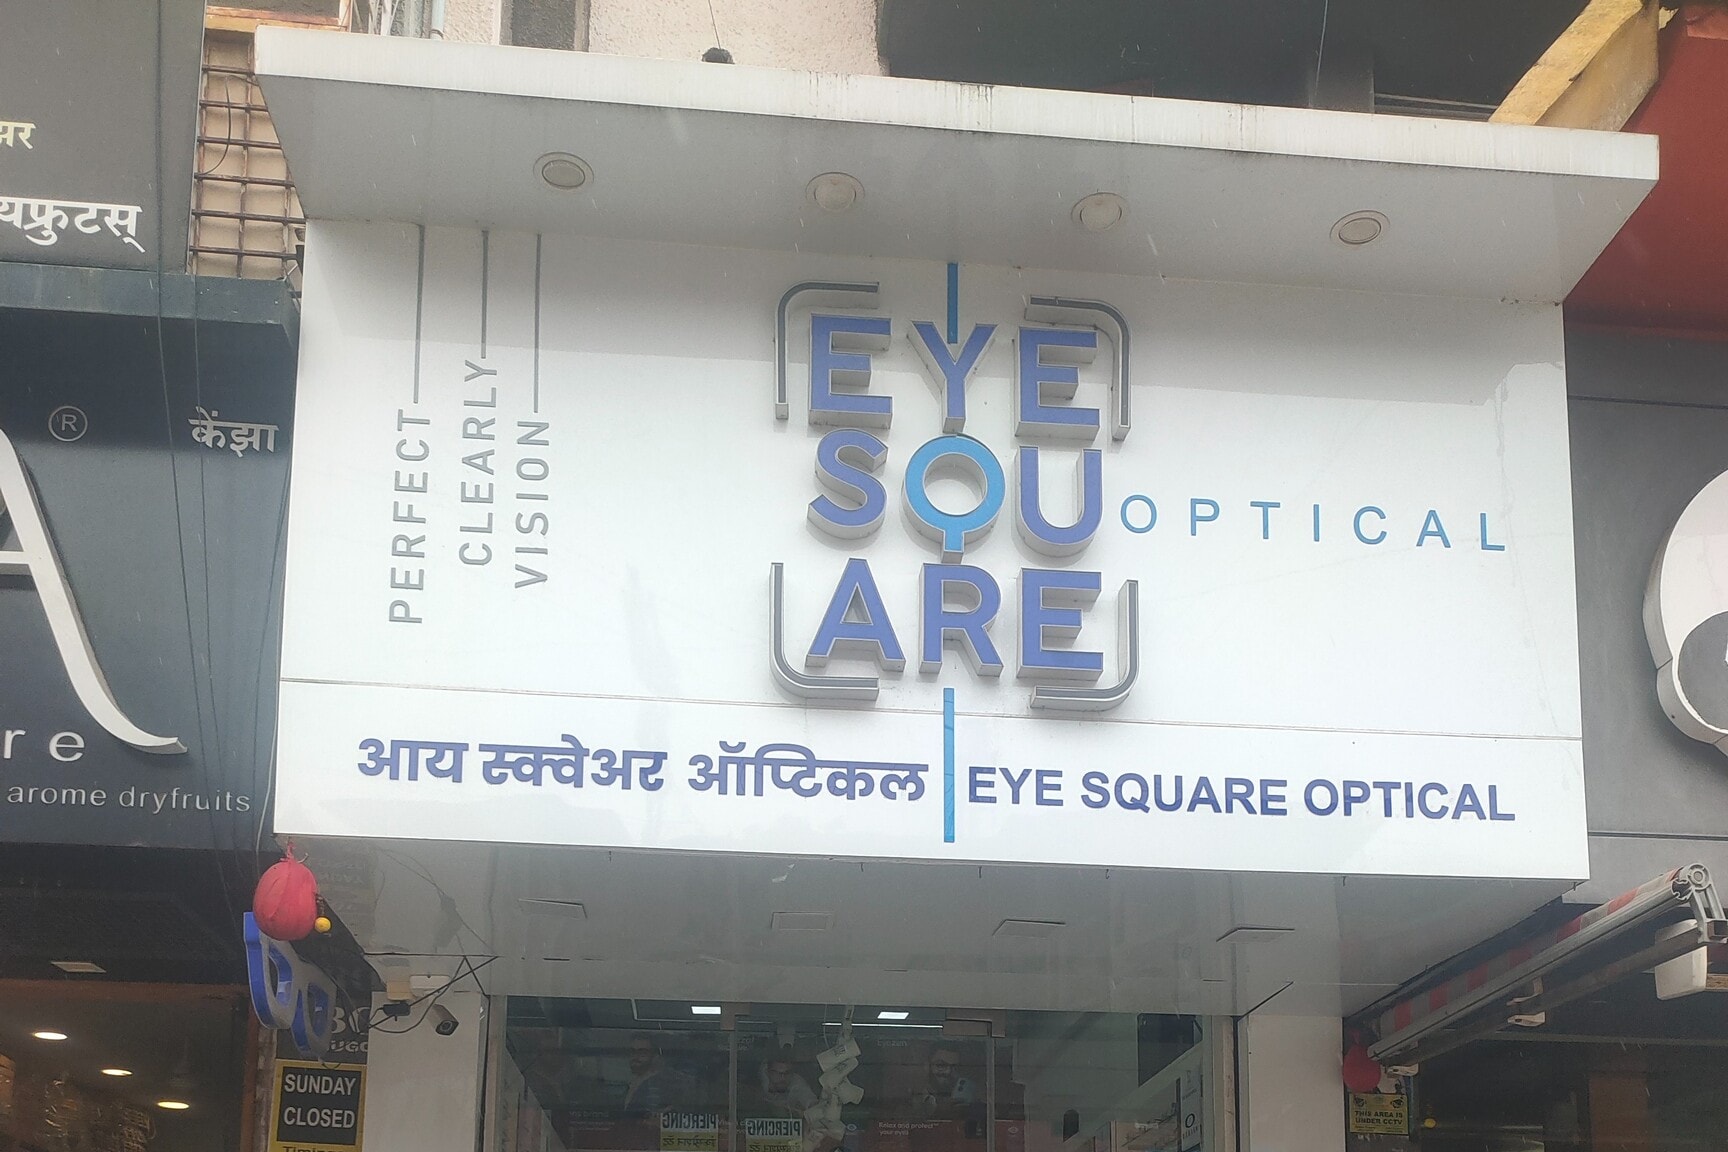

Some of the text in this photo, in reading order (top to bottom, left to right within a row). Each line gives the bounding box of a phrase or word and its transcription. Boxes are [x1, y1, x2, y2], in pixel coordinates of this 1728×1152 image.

[458, 359, 499, 567] CLEARLY
[389, 408, 431, 624] PERFECT
[515, 420, 552, 590] VISION
[1120, 493, 1506, 552] OPTICAL
[357, 733, 929, 803] आय स्क्वेअर ऑप्टिकल
[967, 767, 1515, 822] EYE SQUARE OPTICAL
[7, 784, 251, 816] arome dryfruits
[283, 1073, 357, 1097] SUNDAY
[282, 1106, 356, 1130] CLOSED
